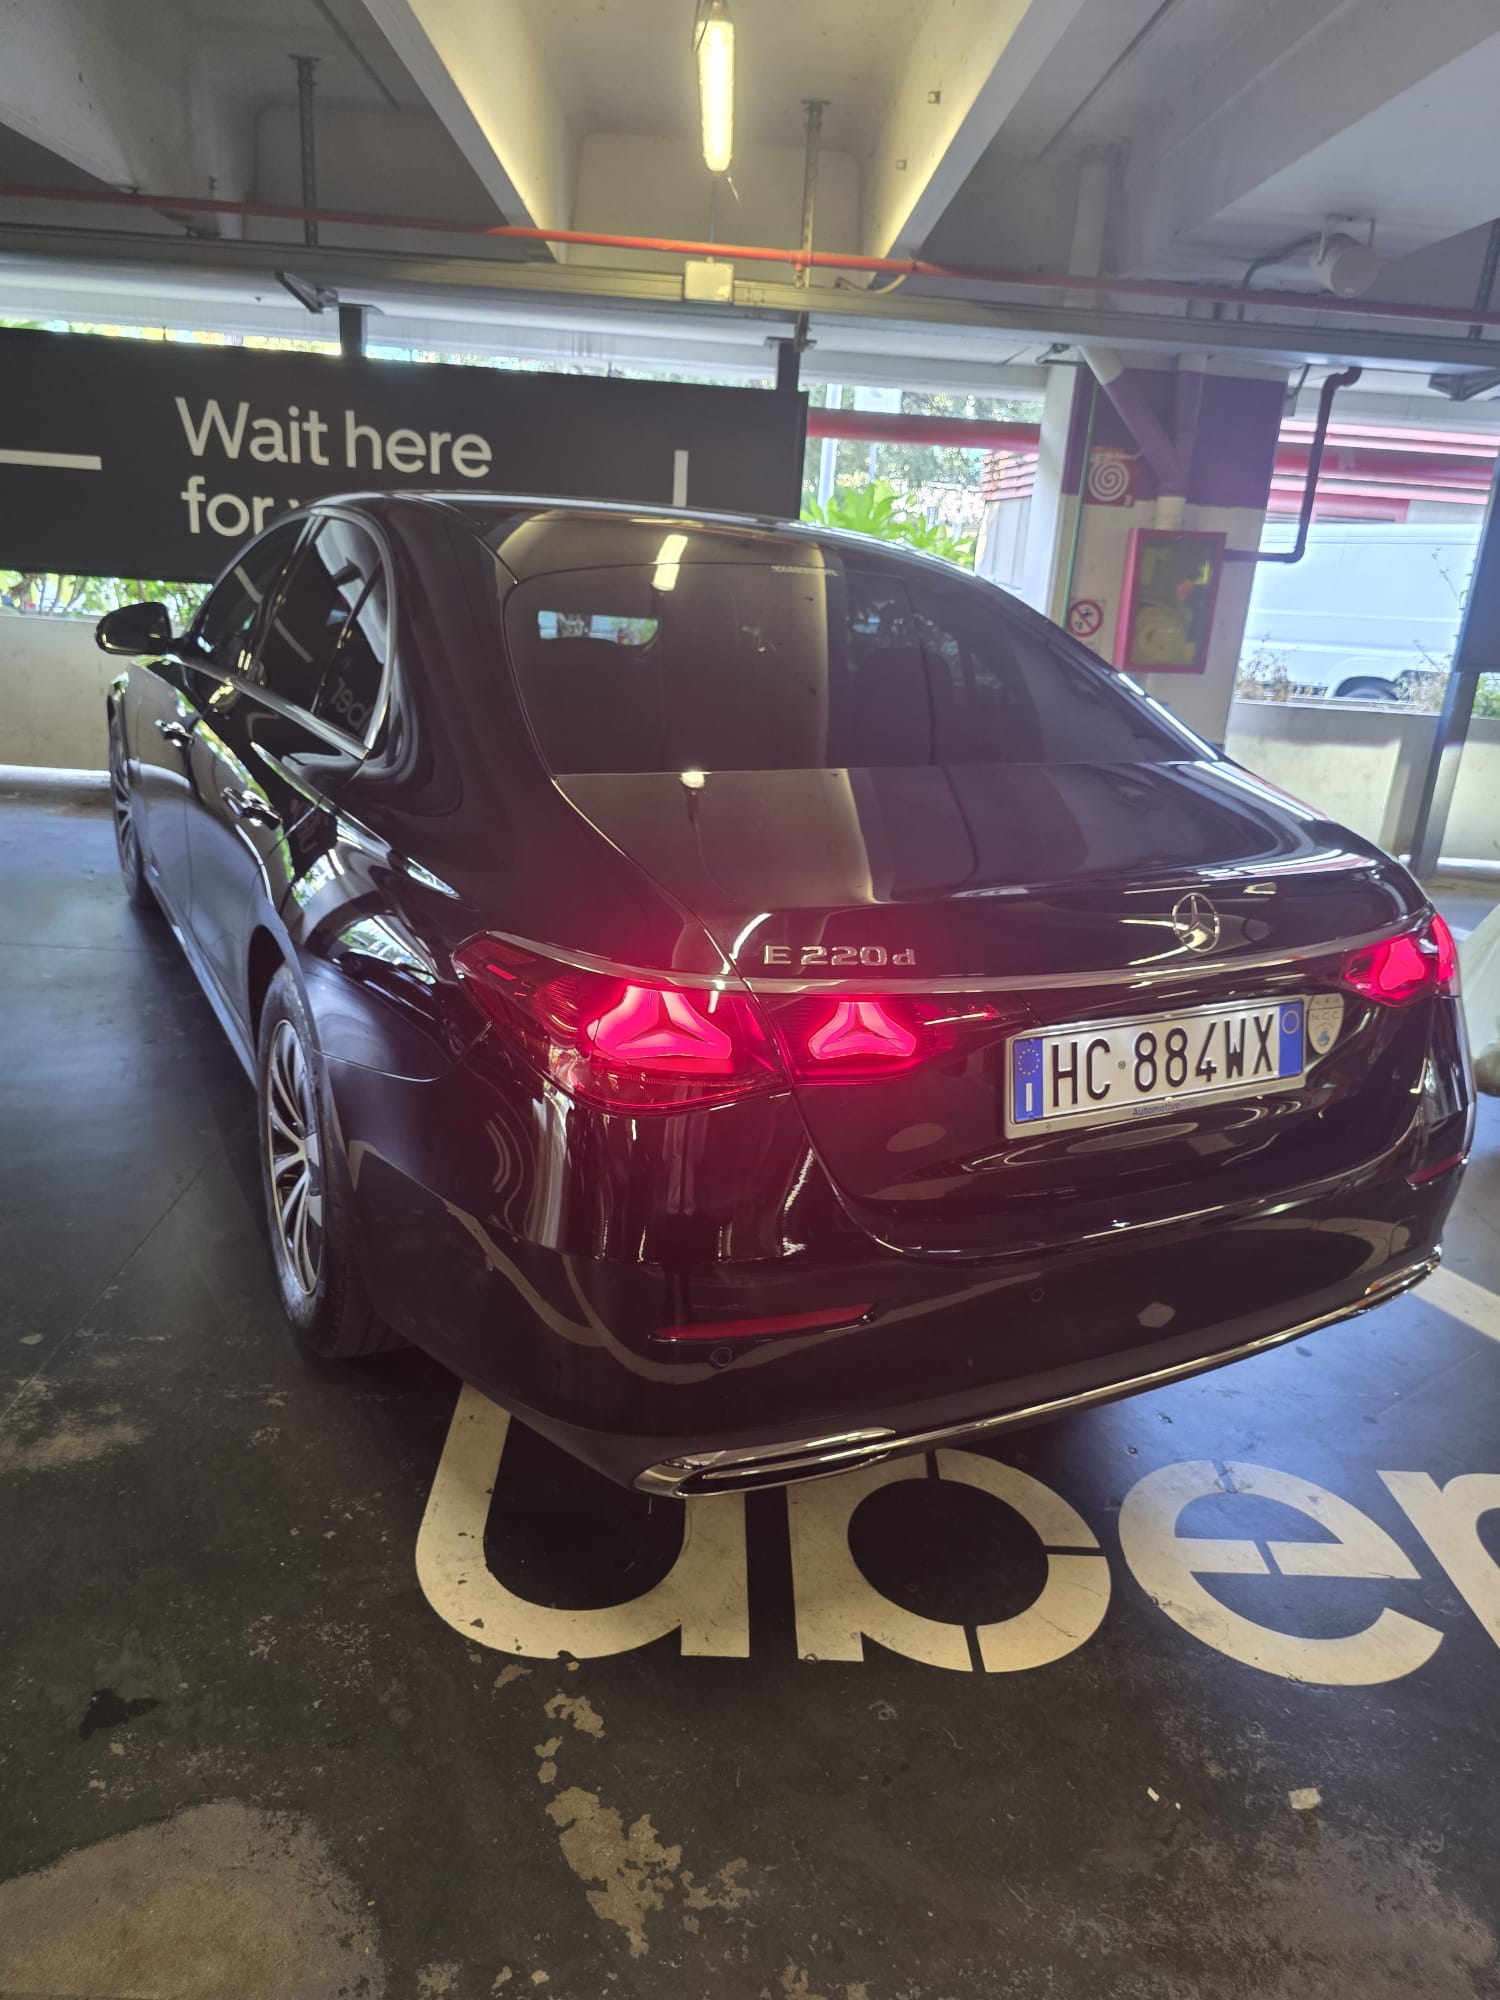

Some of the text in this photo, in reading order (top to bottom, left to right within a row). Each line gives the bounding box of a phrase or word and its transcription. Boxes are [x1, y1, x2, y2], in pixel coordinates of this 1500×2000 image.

[175, 397, 493, 478] Wait here
[180, 475, 275, 537] for
[1133, 1013, 1275, 1093] 884WX
